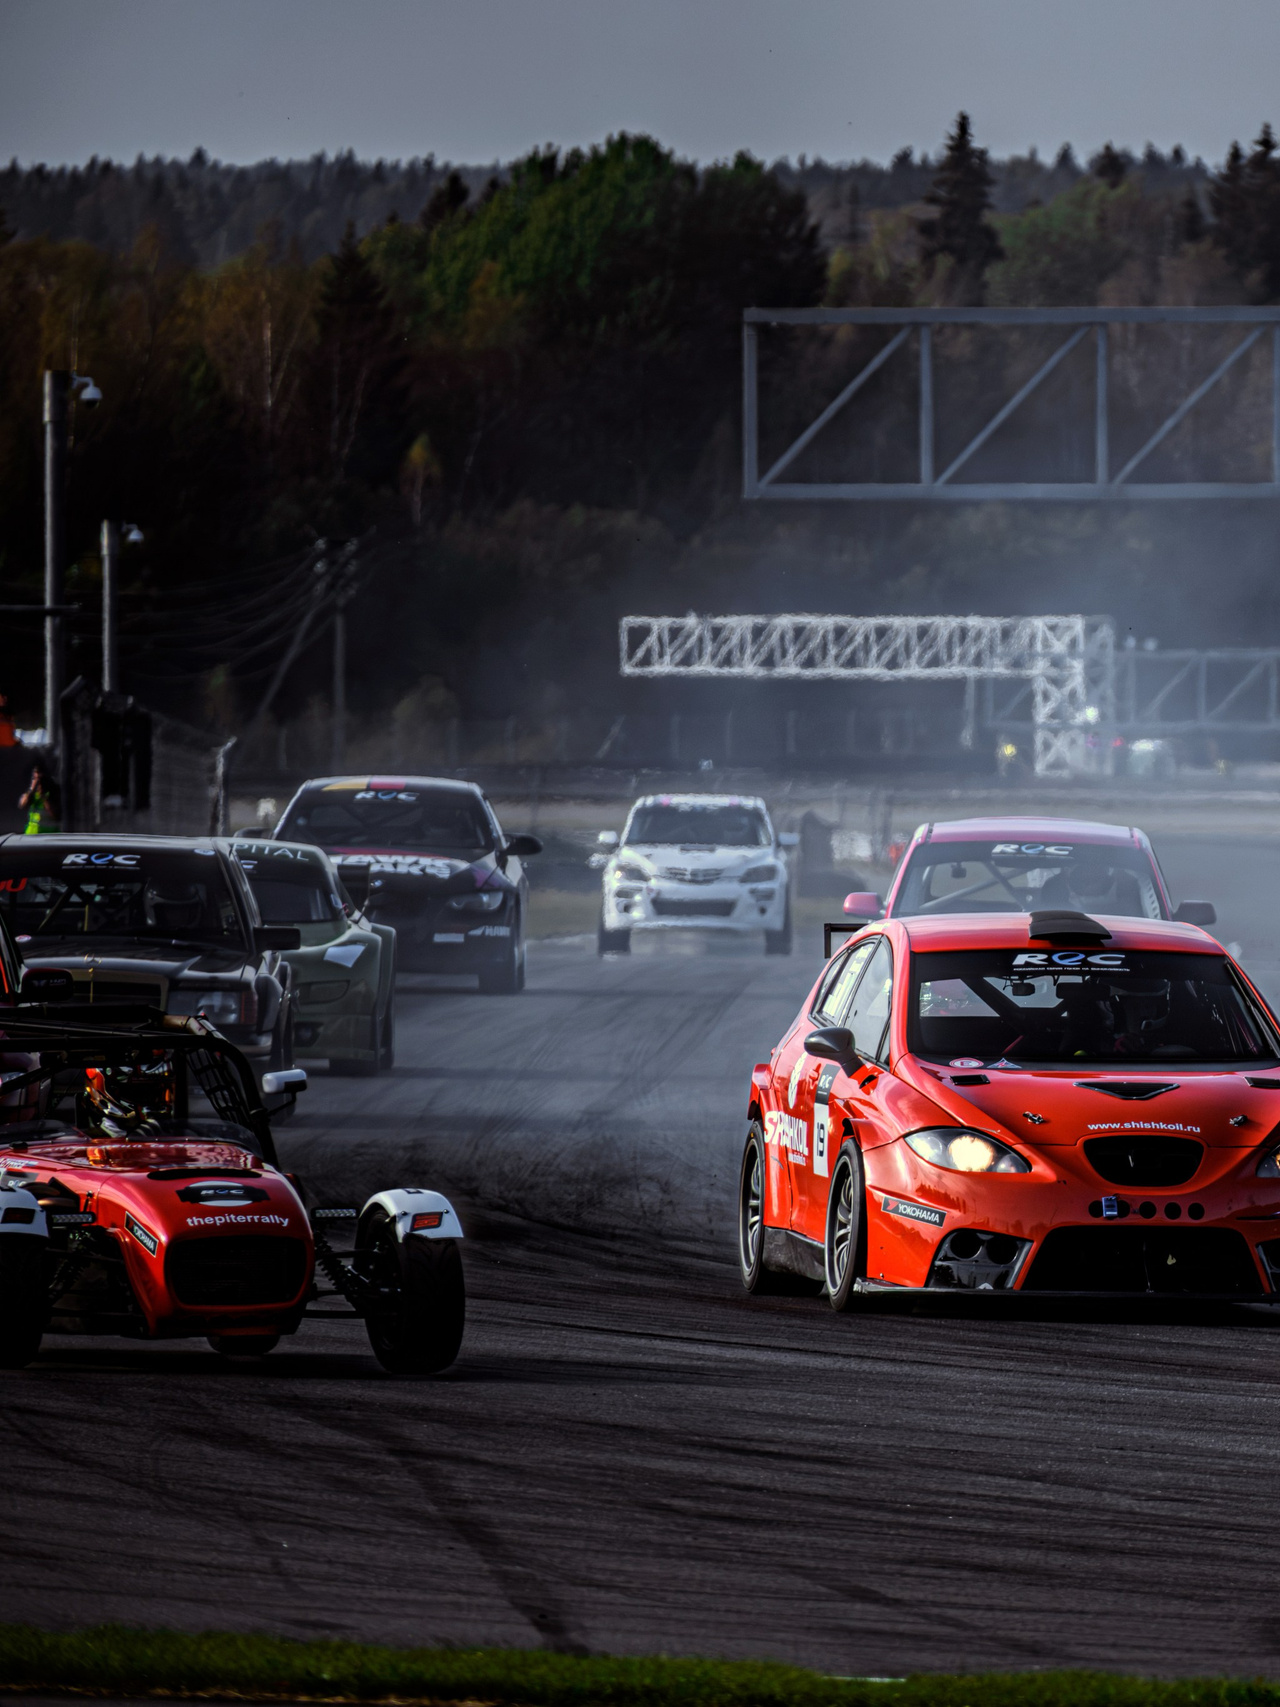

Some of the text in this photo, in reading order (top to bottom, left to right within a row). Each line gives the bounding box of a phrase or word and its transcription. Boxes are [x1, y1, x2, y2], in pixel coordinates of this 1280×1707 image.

[1087, 1121, 1200, 1133] www.shishkoil.ru
[186, 1213, 290, 1228] thepiterrally
[898, 1203, 940, 1224] YOKOHAMA
